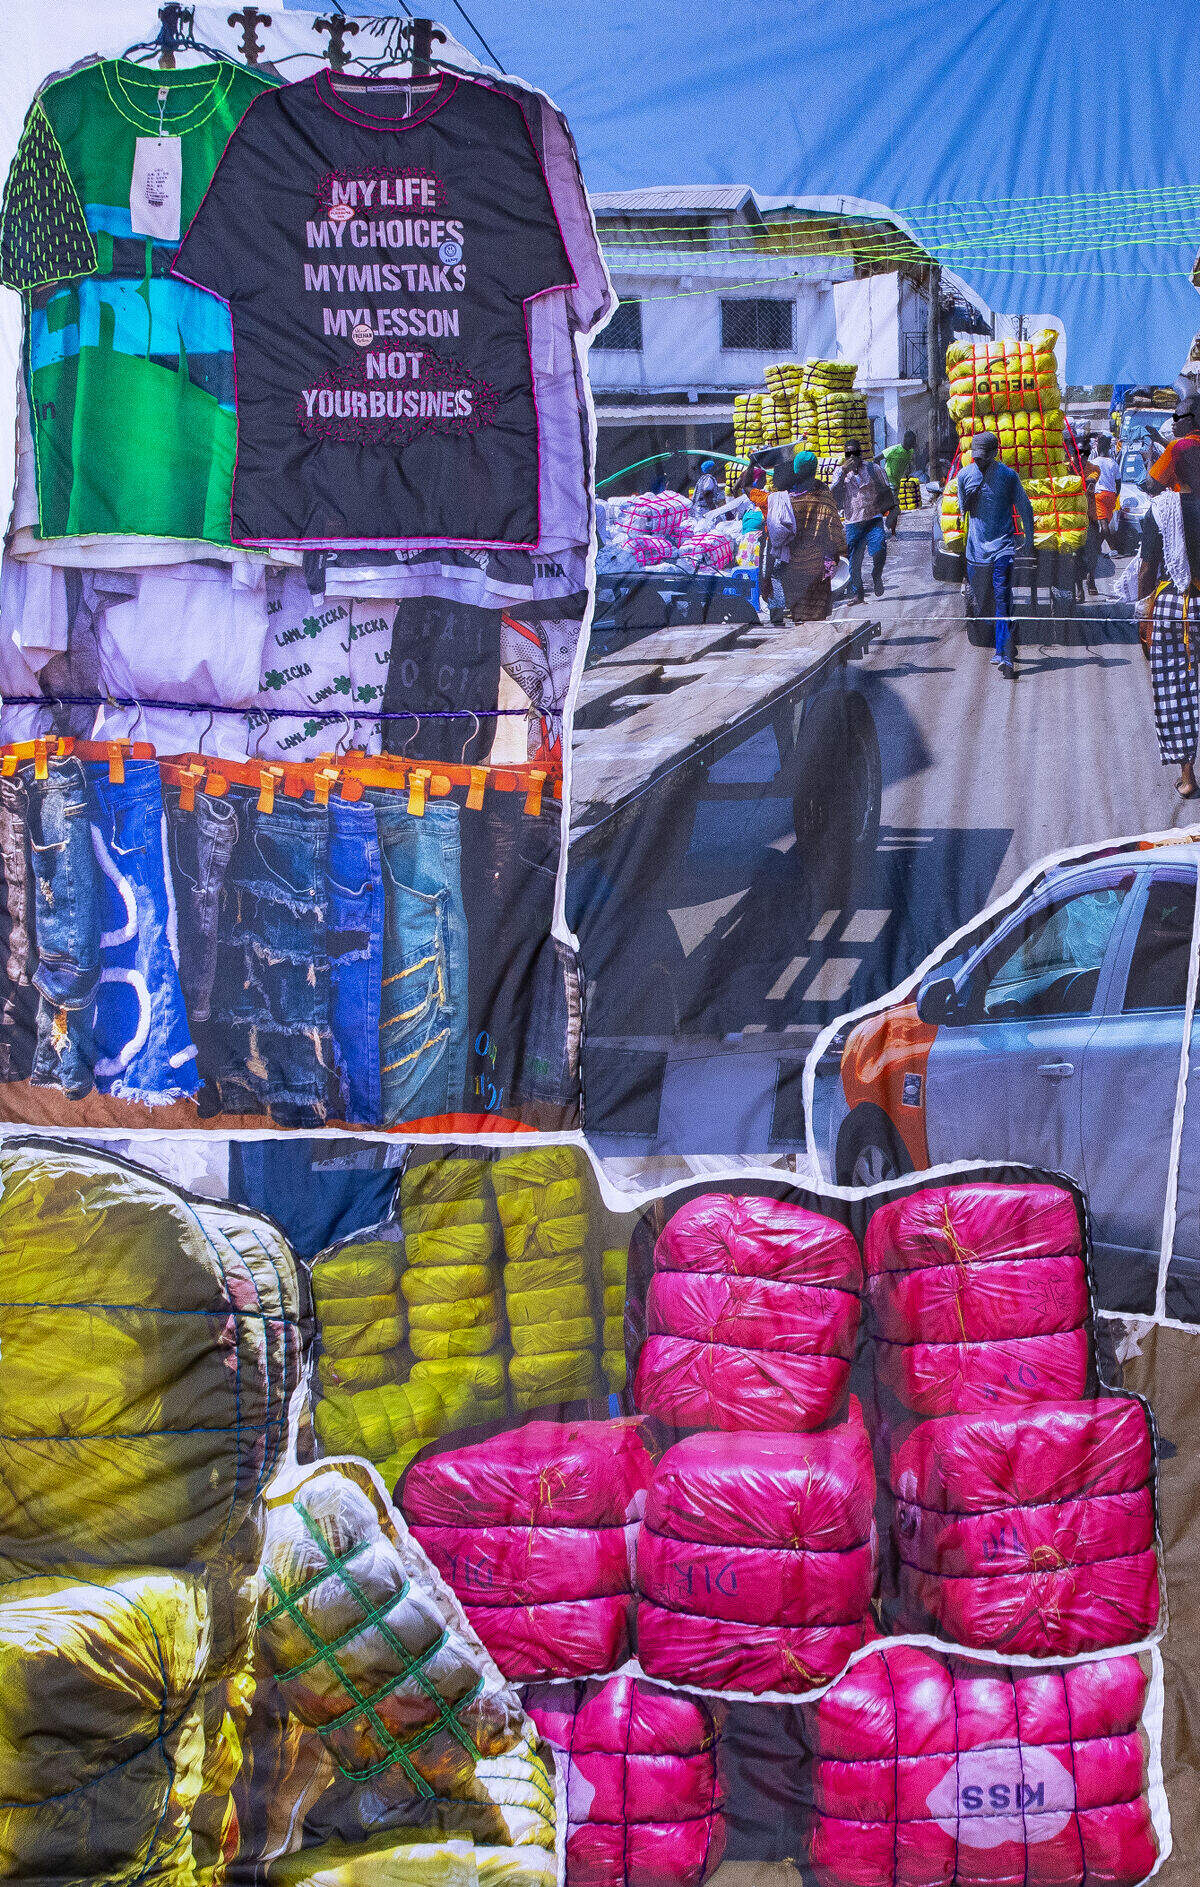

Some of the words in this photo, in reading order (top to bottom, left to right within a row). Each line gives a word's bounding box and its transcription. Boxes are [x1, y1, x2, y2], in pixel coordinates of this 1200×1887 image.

[366, 351, 424, 380] NOT
[977, 378, 1035, 394] HELLO
[961, 1781, 1045, 1811] KISS
